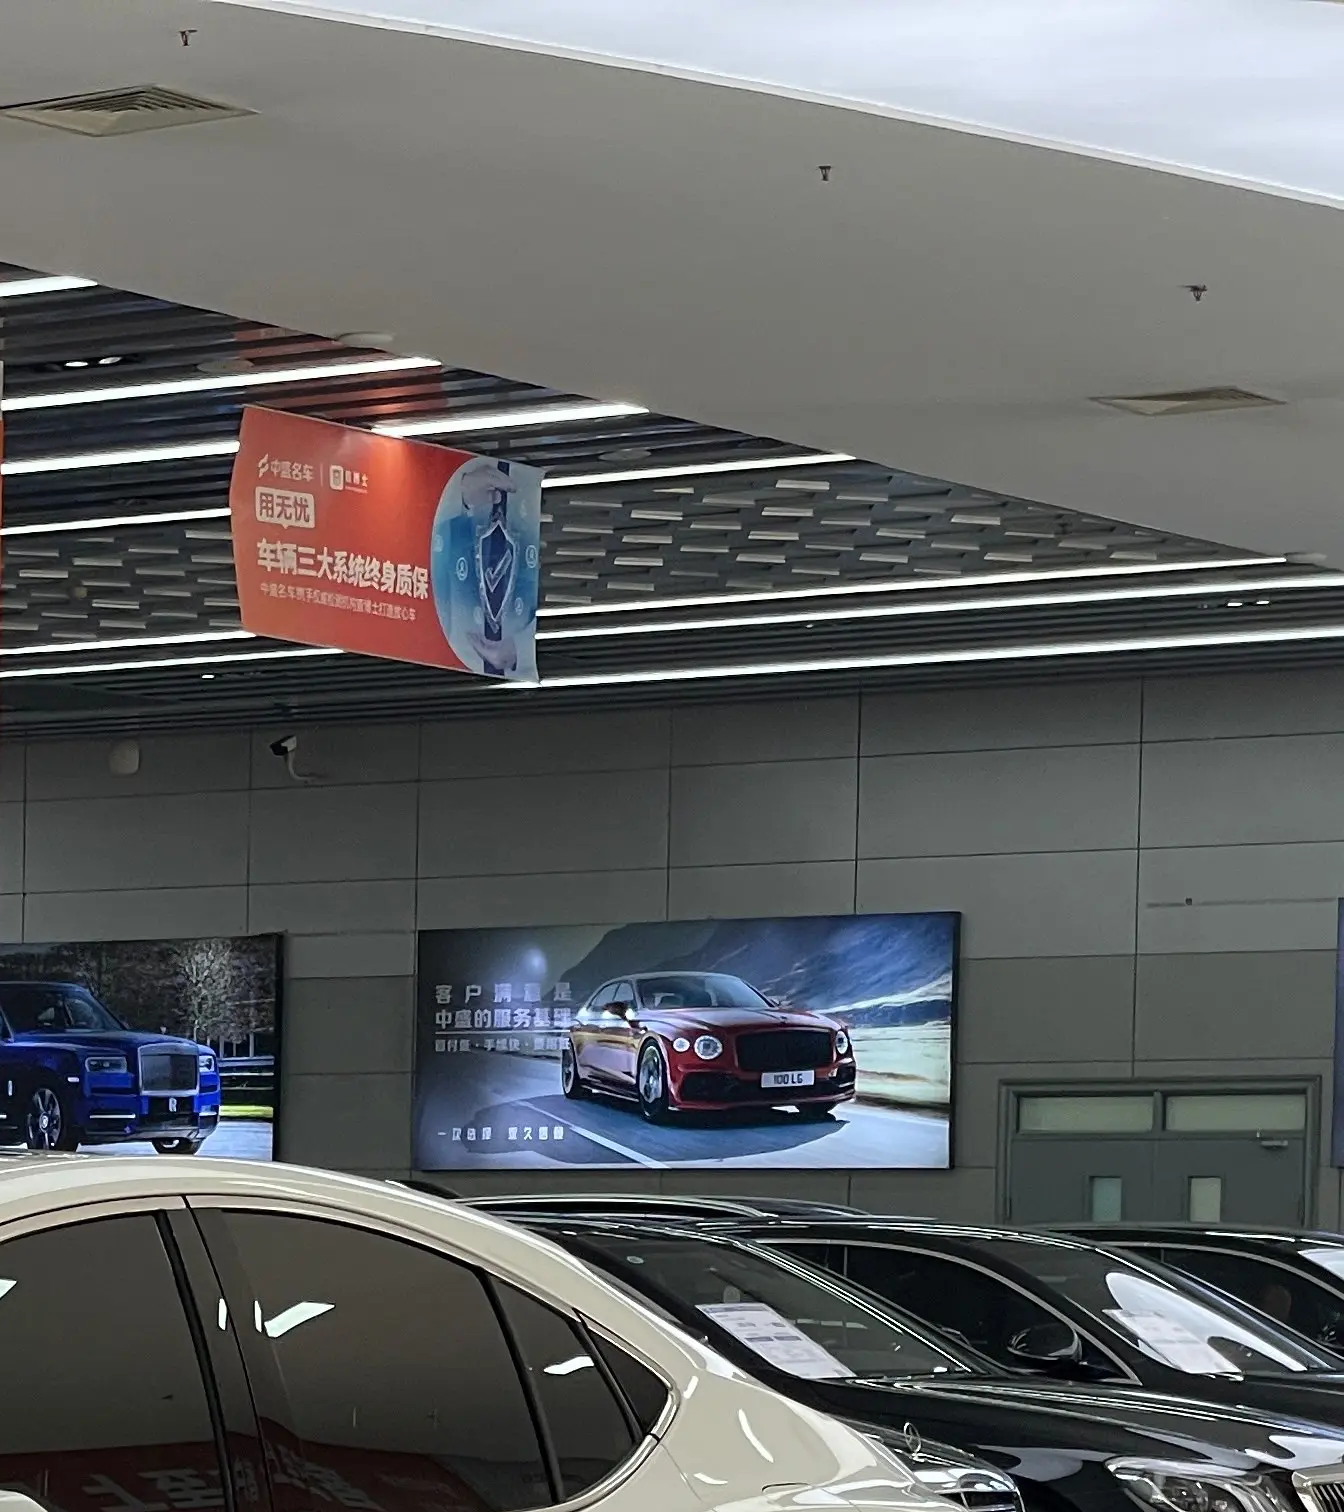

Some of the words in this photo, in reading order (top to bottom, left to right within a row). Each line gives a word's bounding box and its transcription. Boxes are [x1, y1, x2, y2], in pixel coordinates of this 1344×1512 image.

[259, 491, 311, 524] 用无忧
[256, 537, 430, 601] 车辆三大系统终身质保
